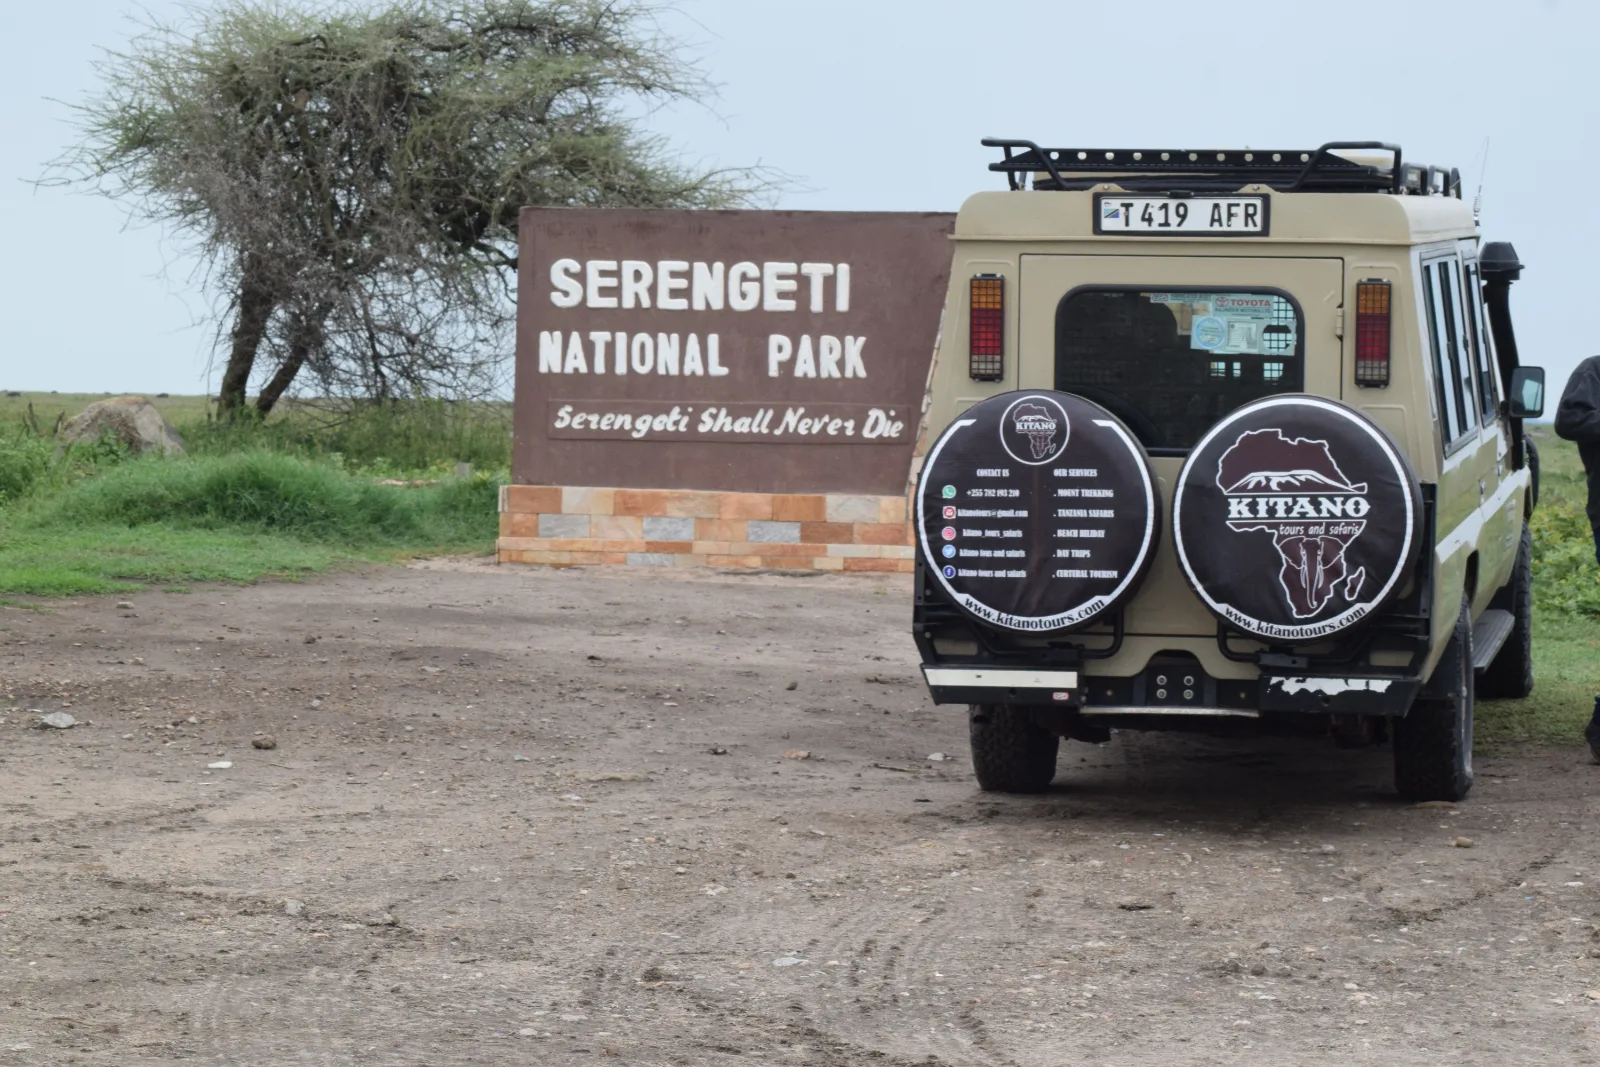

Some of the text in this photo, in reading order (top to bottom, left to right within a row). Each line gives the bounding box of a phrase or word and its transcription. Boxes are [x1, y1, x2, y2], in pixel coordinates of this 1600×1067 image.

[1120, 202, 1258, 228] T 419 AFR
[550, 258, 850, 313] SERENGETI
[1230, 298, 1271, 307] TOYOTA
[538, 330, 868, 379] NATIONAL PARK
[554, 404, 904, 439] Serengeti Shall Never Die
[1015, 422, 1056, 430] KITANO
[976, 468, 1010, 477] CONTACT US
[1053, 468, 1098, 477] OUR SERVICES
[966, 489, 983, 497] +255
[1057, 488, 1114, 498] MOUNT TREKKING
[1227, 497, 1371, 519] KITANO
[1057, 509, 1115, 518] TANZANIA SAFARIS
[1057, 529, 1078, 538] BEACH
[1279, 522, 1360, 536] tours and safaris
[959, 548, 979, 557] kitano
[993, 549, 1005, 557] and
[1006, 549, 1026, 558] safaris
[1056, 549, 1091, 558] DAY TRIPS
[957, 568, 977, 577] kitano
[994, 569, 1006, 577] and
[1007, 569, 1027, 578] safaris
[1089, 570, 1118, 579] TOURISM
[964, 598, 1105, 630] www.kitanotours.com
[1225, 606, 1366, 638] www.kitanotours.com
